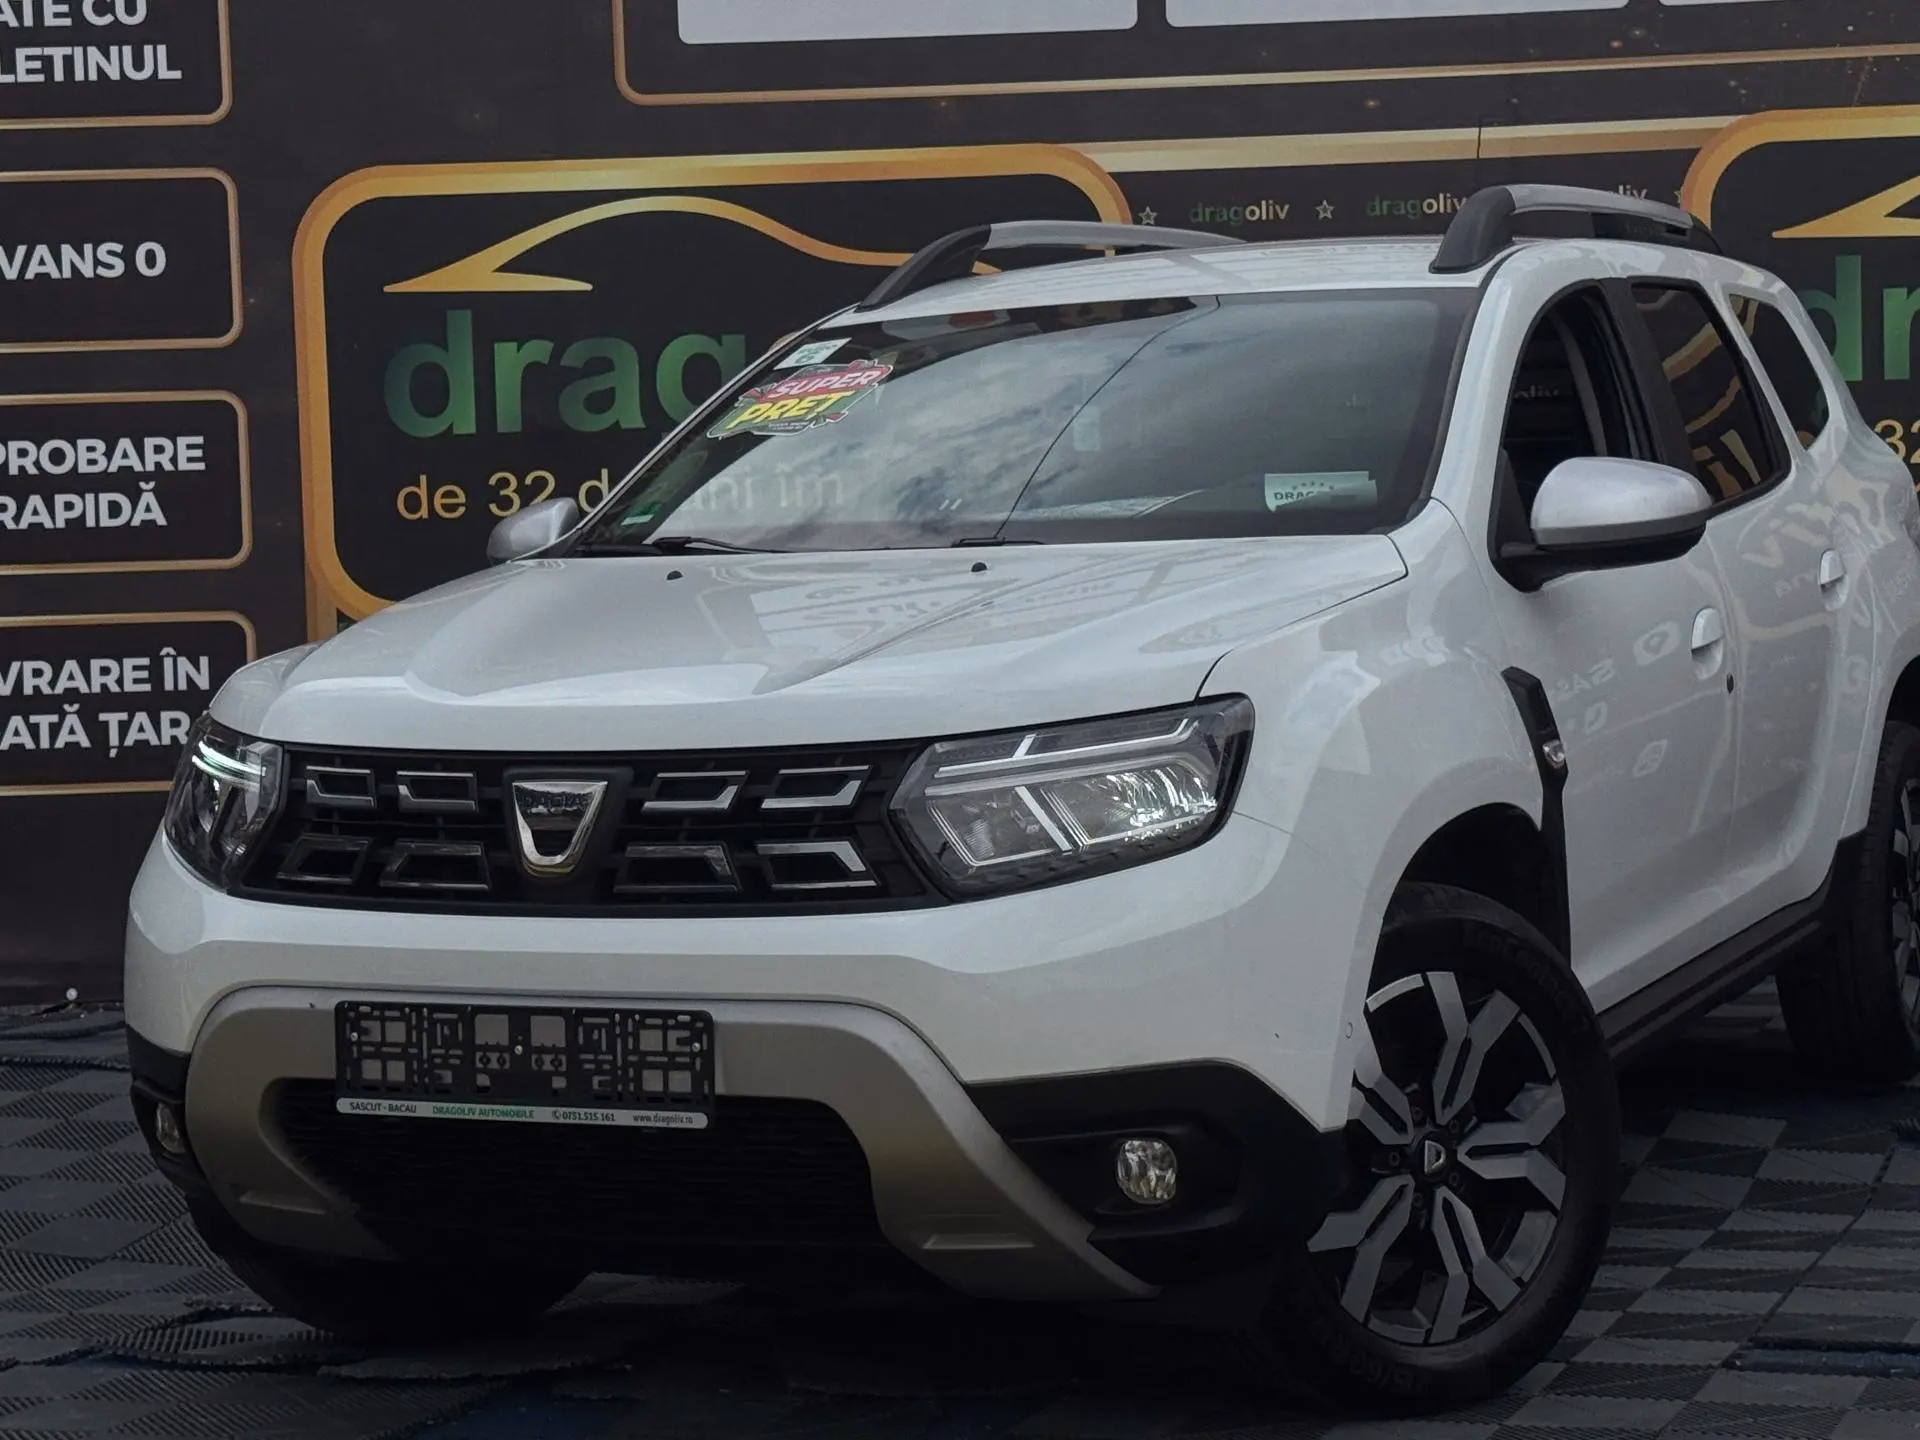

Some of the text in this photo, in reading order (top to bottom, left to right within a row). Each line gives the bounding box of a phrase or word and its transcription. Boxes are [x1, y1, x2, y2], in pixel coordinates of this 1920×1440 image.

[82, 0, 147, 26] CU
[1189, 200, 1290, 226] dragoliv
[768, 370, 882, 398] SUPER
[0, 436, 206, 476] ROBARE
[396, 474, 467, 520] de
[159, 646, 210, 691] ÎN
[432, 1106, 476, 1116] DRAGOLIV
